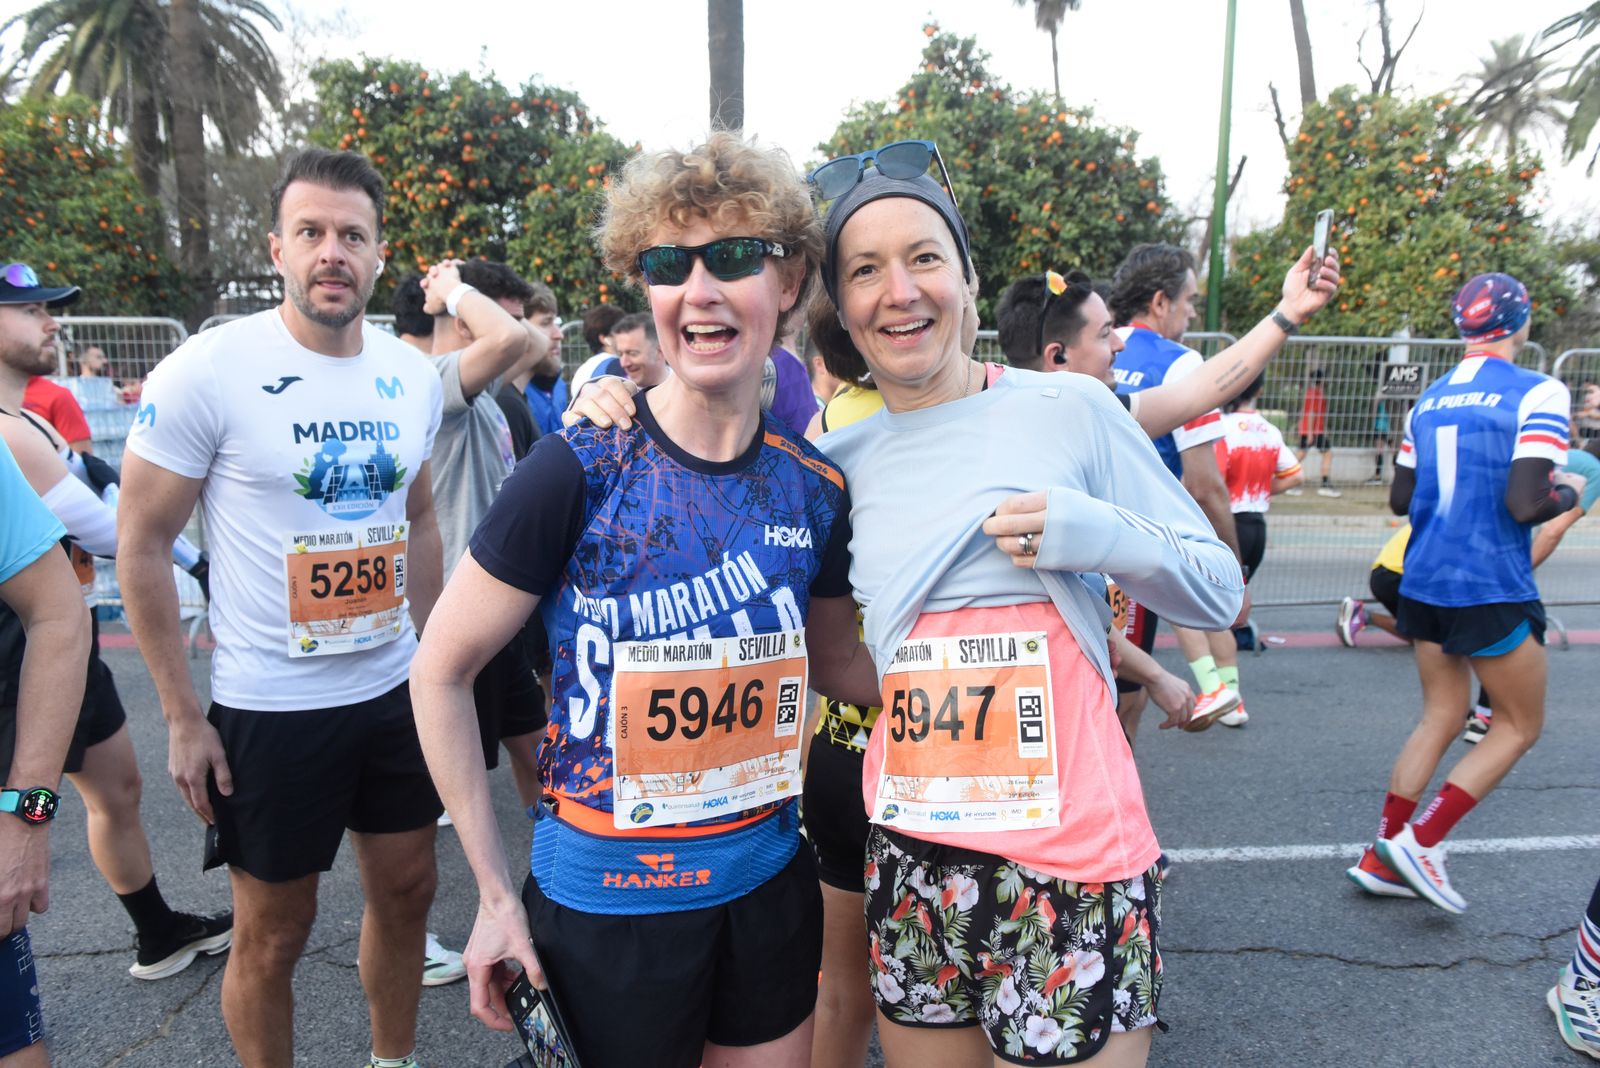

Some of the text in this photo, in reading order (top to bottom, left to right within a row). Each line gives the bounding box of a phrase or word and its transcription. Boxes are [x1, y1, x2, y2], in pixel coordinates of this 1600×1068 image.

[1390, 366, 1419, 382] AMS
[1436, 392, 1502, 410] PUEBLA
[293, 421, 400, 444] MADRID
[319, 530, 353, 546] MARATÓN
[764, 525, 812, 548] HOKA
[310, 556, 387, 599] 5258
[629, 550, 768, 637] MARATÓN
[628, 633, 786, 662] MEDIO MARATÓN SEVILLA
[958, 637, 1018, 664] SEVILLA
[647, 679, 764, 741] 5946
[891, 686, 995, 743] 5947
[620, 713, 628, 739] CAJÓN
[702, 796, 729, 809] HOKA
[930, 811, 960, 821] HOKA
[603, 869, 711, 888] HANKER
